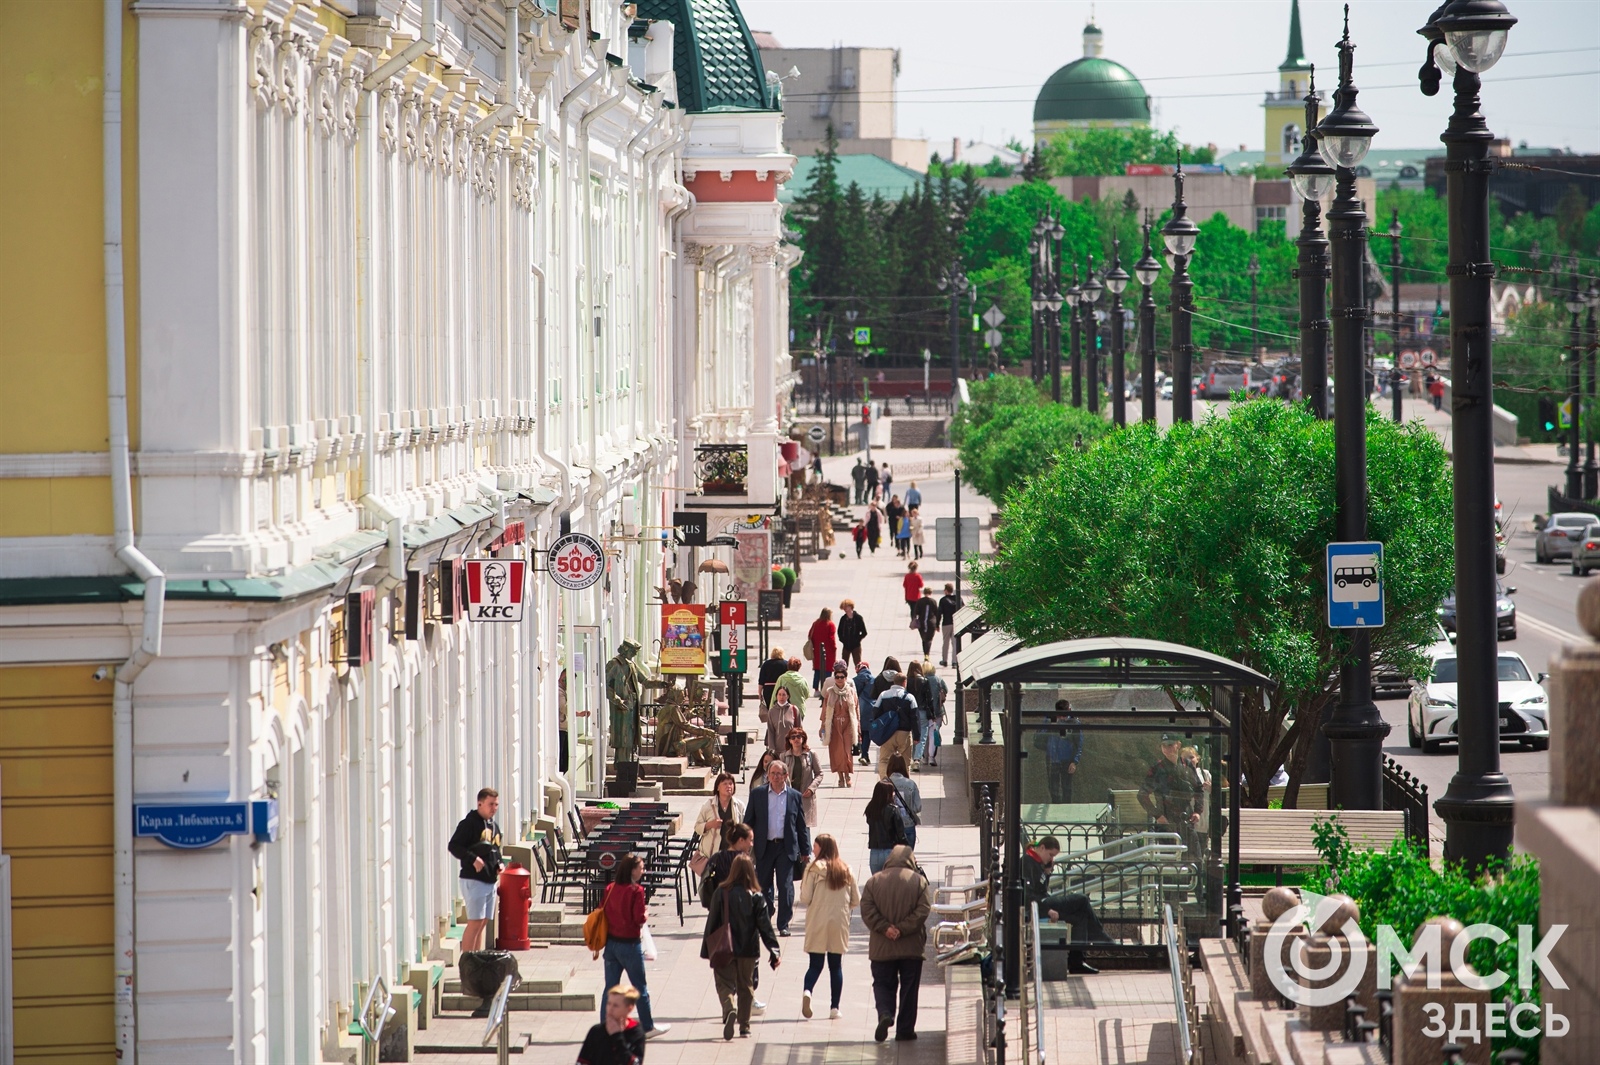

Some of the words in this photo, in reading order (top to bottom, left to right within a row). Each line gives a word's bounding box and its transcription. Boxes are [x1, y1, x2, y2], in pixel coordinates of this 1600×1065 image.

[477, 605, 513, 618] KFC
[728, 606, 738, 669] PIZZA
[141, 815, 173, 829] Карла
[236, 813, 243, 825] 8
